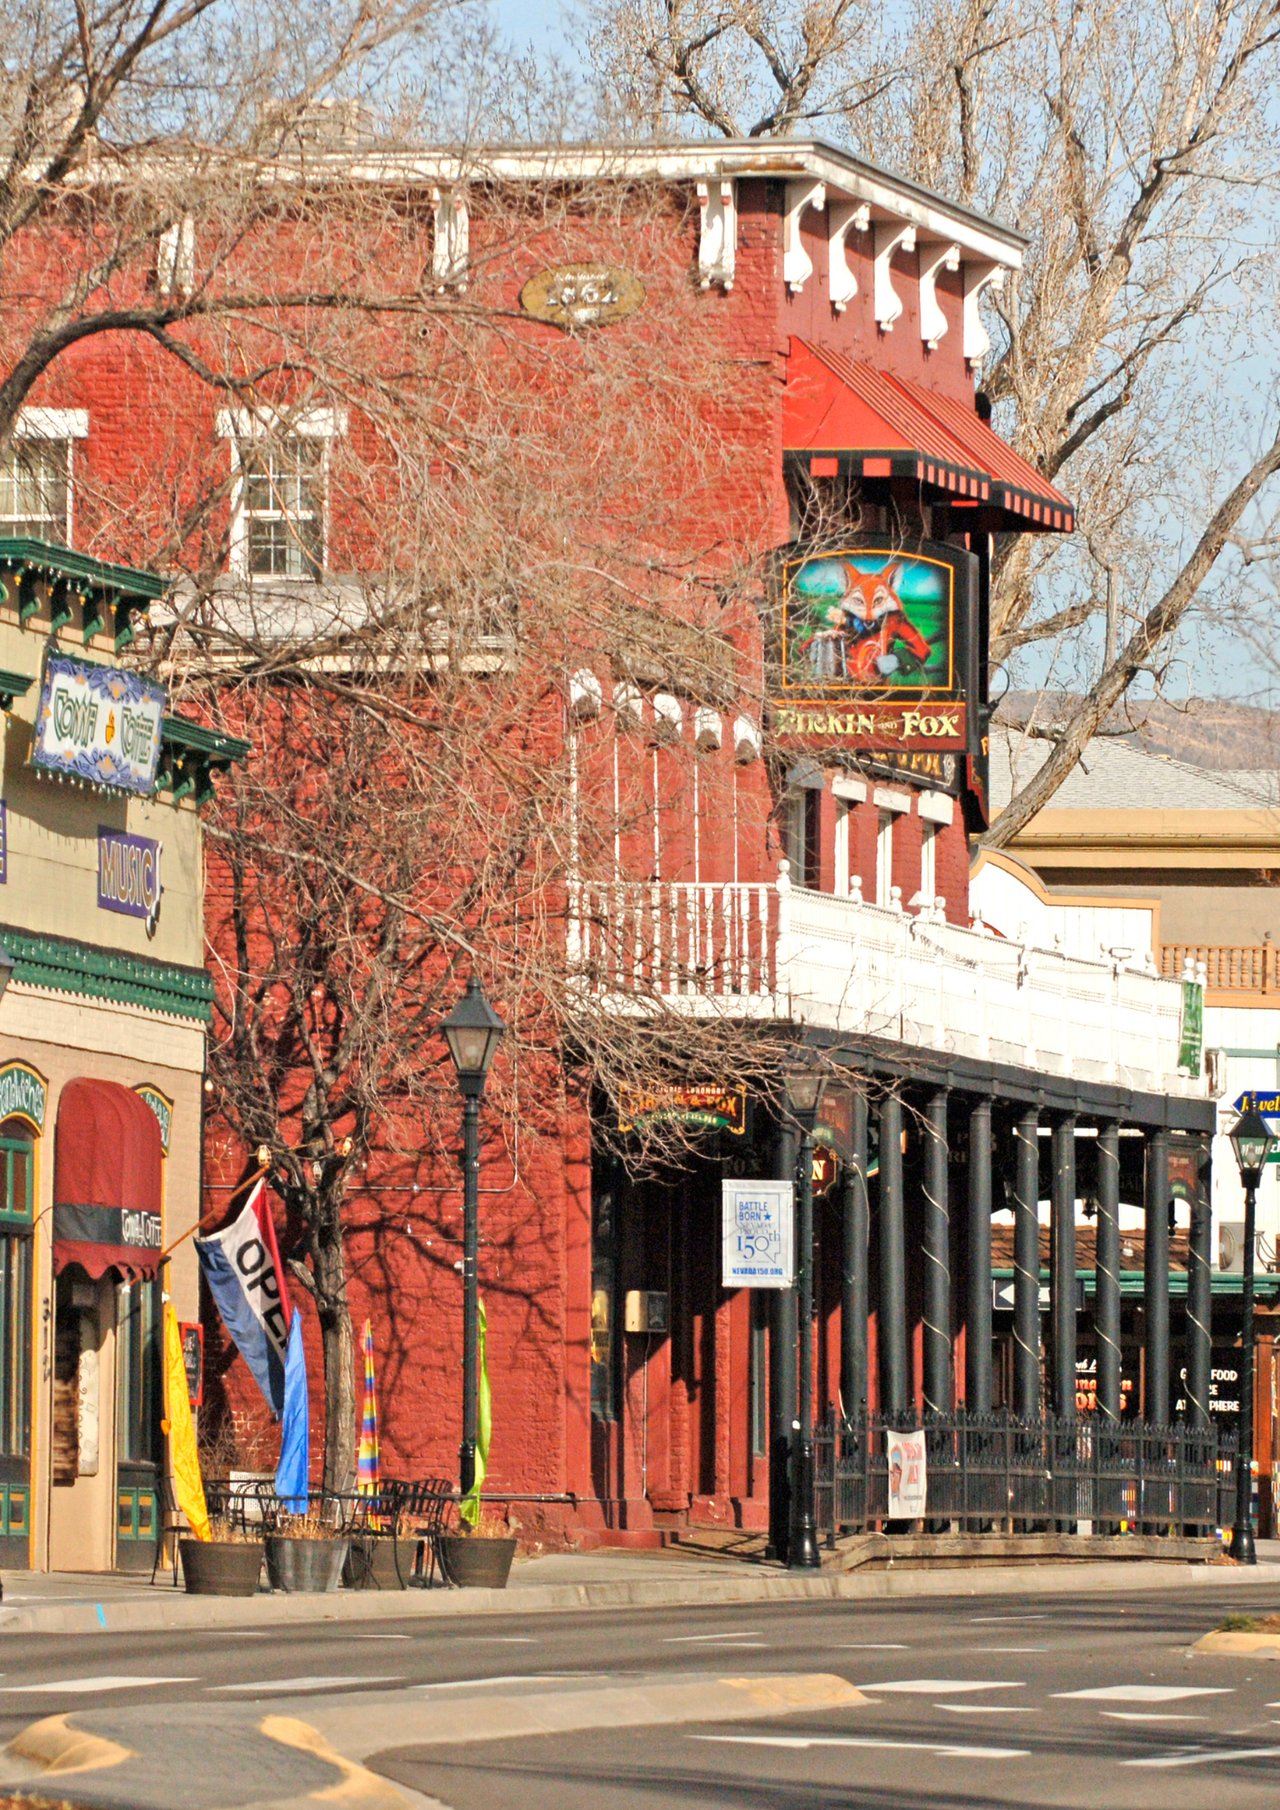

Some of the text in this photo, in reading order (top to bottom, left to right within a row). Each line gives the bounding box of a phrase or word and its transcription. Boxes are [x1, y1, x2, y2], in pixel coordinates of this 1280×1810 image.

[100, 838, 154, 909] MUSIC
[739, 1201, 768, 1211] BATTLE
[739, 1211, 761, 1221] BORN
[732, 1267, 783, 1276] NEVADA150.ORG
[236, 1238, 289, 1350] OPE
[1210, 1368, 1238, 1381] FOOD
